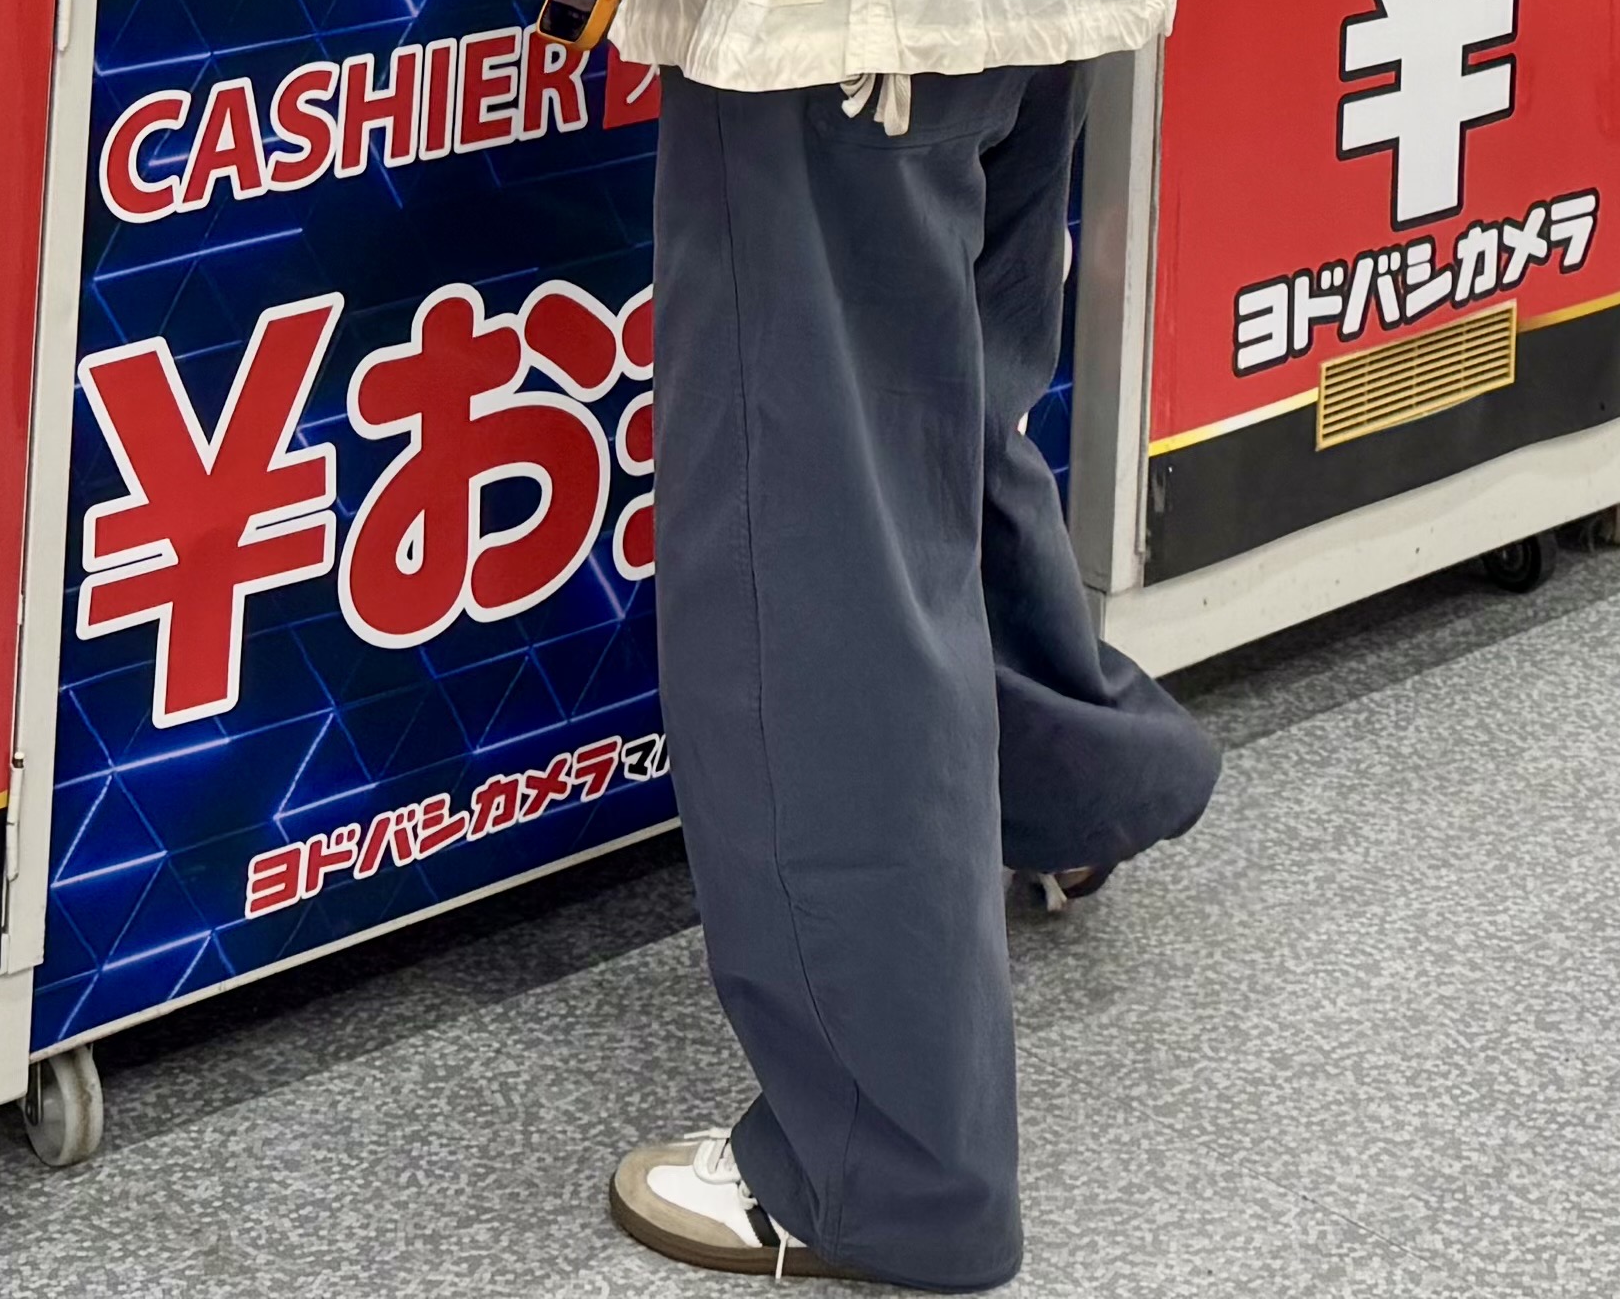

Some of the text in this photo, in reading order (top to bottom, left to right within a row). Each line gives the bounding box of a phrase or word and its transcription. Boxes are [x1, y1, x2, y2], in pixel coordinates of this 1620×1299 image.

[99, 23, 589, 224] CASHIER
[1233, 190, 1601, 376] ヨドバシカメラ
